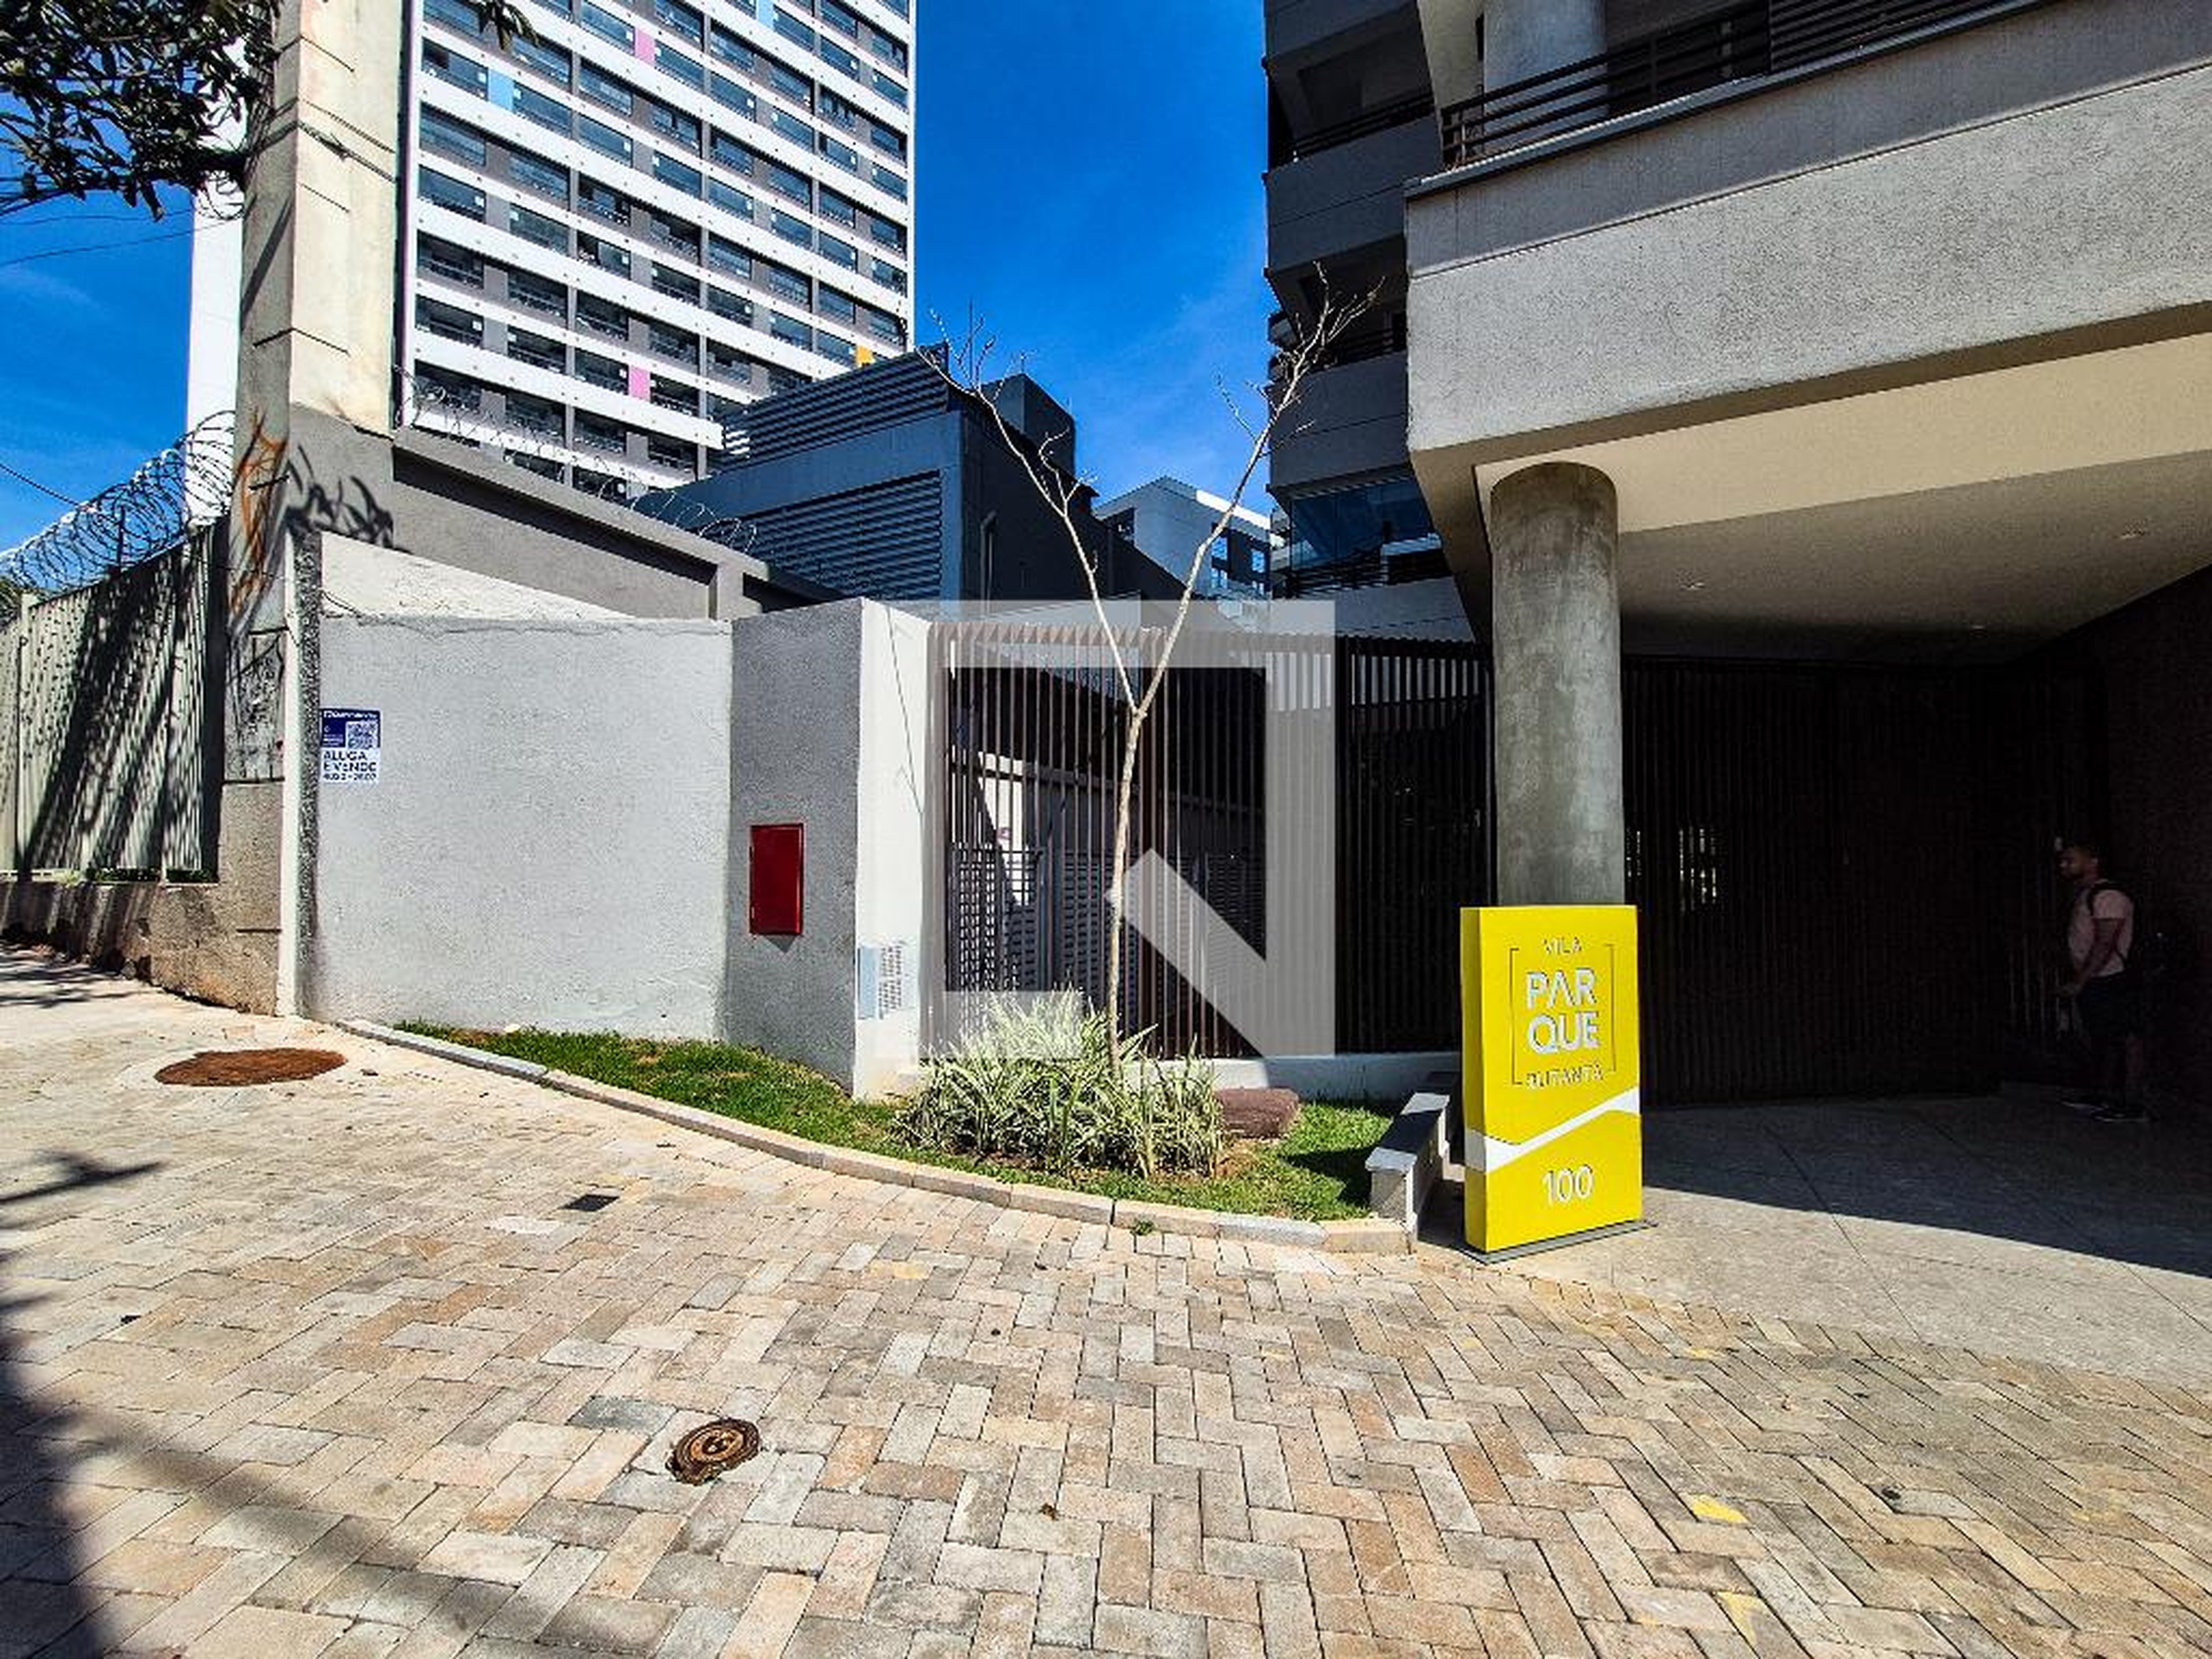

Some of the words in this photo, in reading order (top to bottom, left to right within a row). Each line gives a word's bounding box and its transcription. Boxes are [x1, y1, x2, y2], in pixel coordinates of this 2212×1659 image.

[1541, 936, 1582, 956] VILA
[1527, 967, 1599, 1011] PAR
[1528, 1010, 1601, 1055] QUE
[1541, 1164, 1595, 1208] 100
